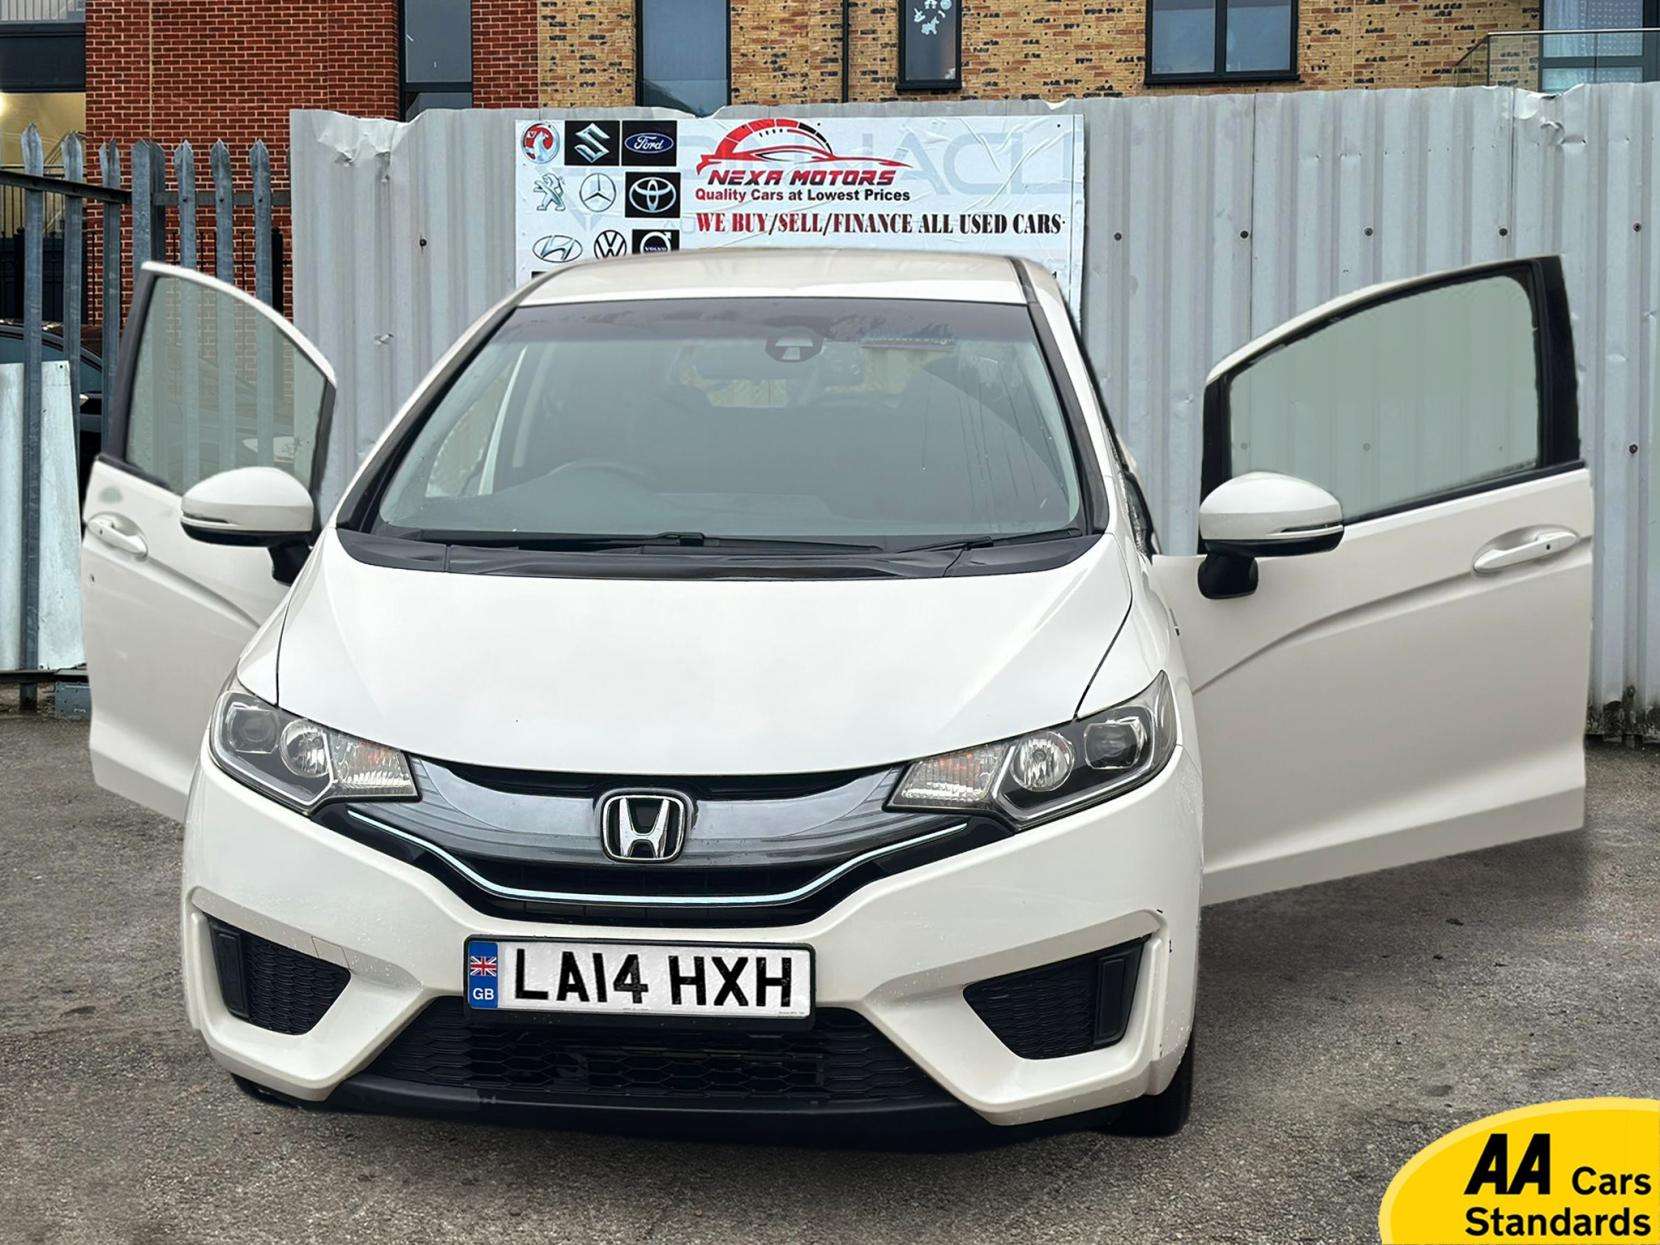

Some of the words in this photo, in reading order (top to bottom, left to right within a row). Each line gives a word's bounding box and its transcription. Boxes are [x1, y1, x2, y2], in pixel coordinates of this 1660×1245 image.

[633, 136, 664, 151] Ford
[707, 170, 784, 186] NEXA
[789, 170, 897, 186] MOTORS
[695, 188, 747, 203] Quality
[750, 188, 784, 201] Cars
[788, 189, 803, 201] at
[807, 188, 860, 201] Lowest
[864, 188, 911, 201] Prices
[696, 212, 726, 233] WE
[918, 213, 954, 234] ALL
[959, 213, 1008, 234] USED
[1012, 213, 1062, 234] CARS
[667, 955, 793, 1008] HXH
[473, 987, 495, 1001] GB
